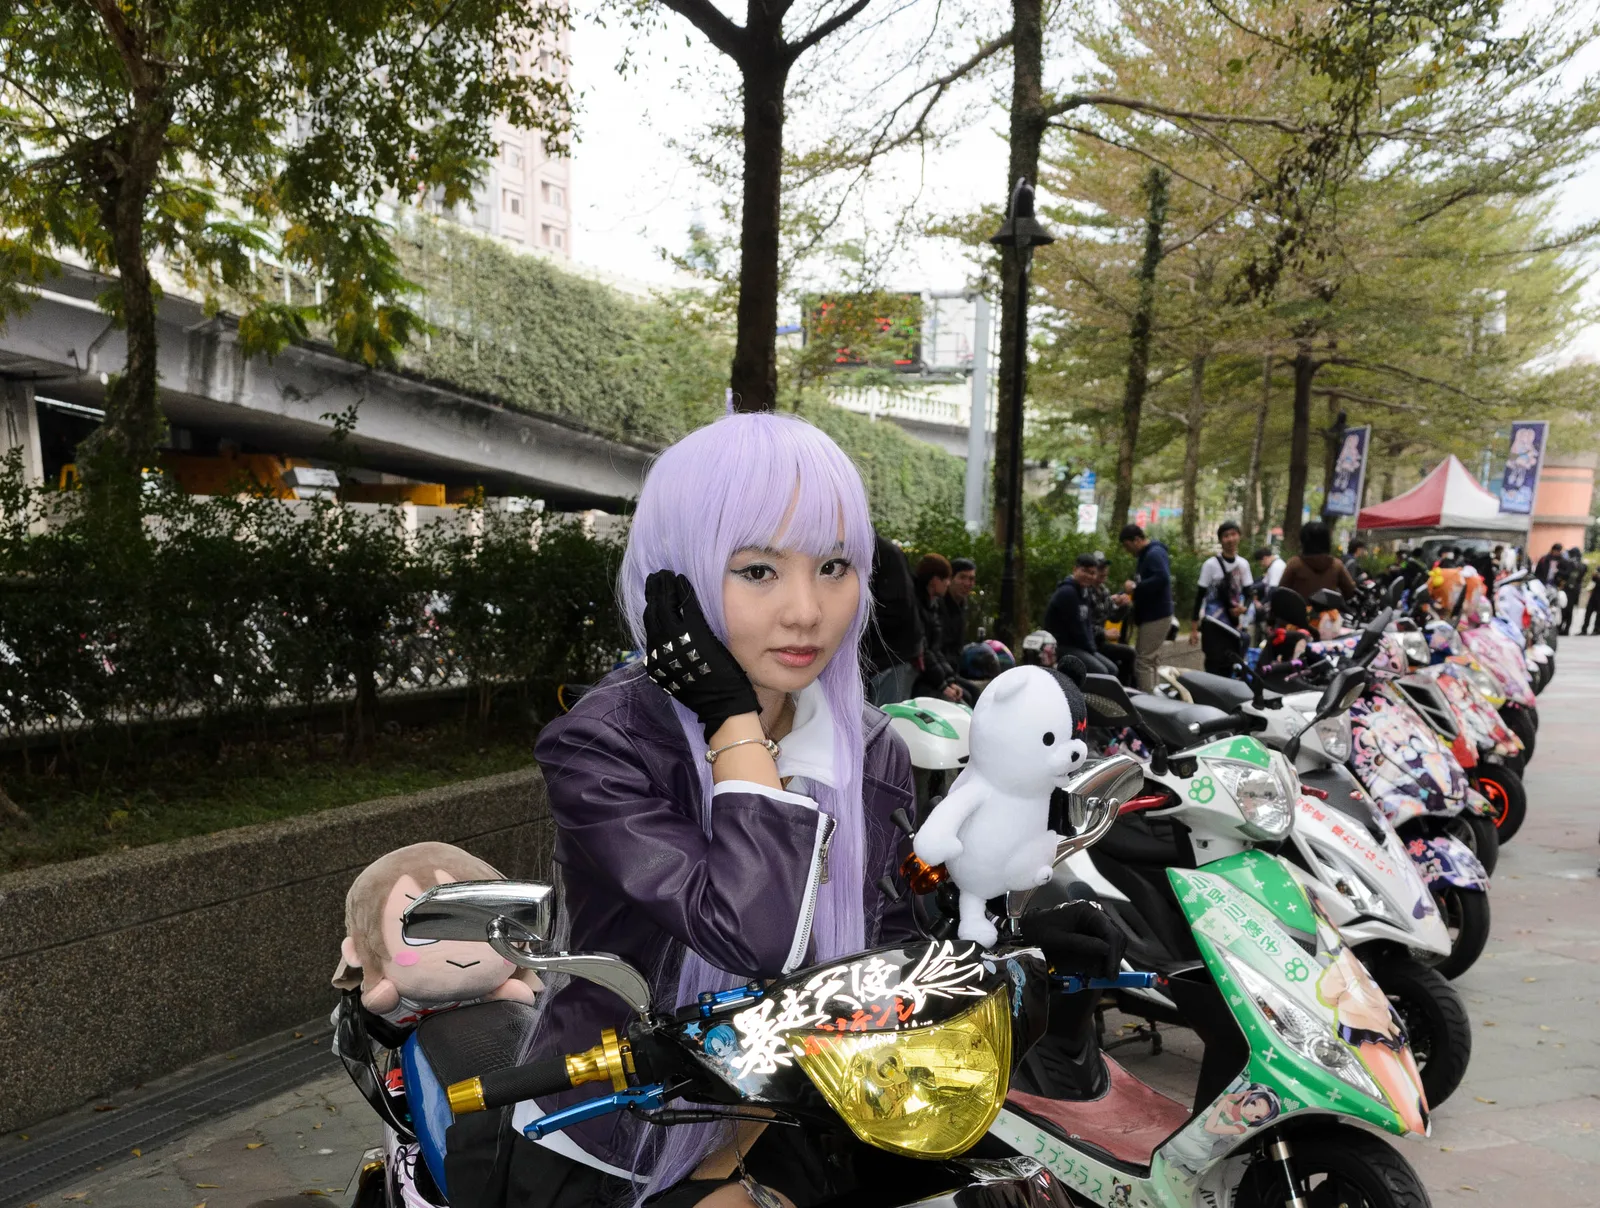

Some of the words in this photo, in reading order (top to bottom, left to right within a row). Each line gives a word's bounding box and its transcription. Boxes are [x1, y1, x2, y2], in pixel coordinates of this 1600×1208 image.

[1035, 1133, 1104, 1199] ラブプラス
